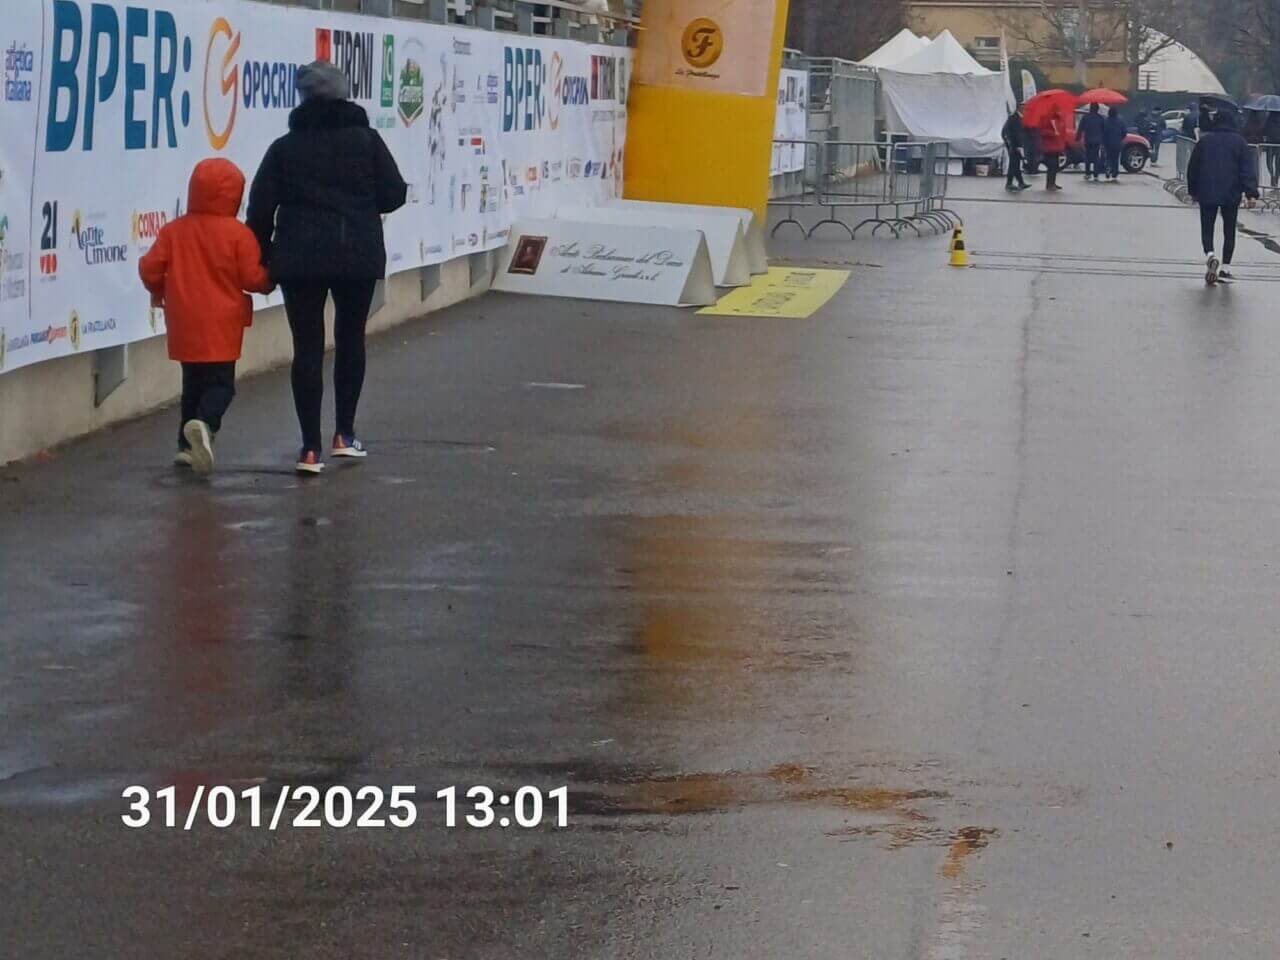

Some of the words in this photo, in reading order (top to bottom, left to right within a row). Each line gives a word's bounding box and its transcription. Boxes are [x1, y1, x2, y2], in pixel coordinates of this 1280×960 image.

[45, 0, 192, 152] BPER:
[503, 46, 546, 132] BPER:
[84, 244, 128, 265] Cimone
